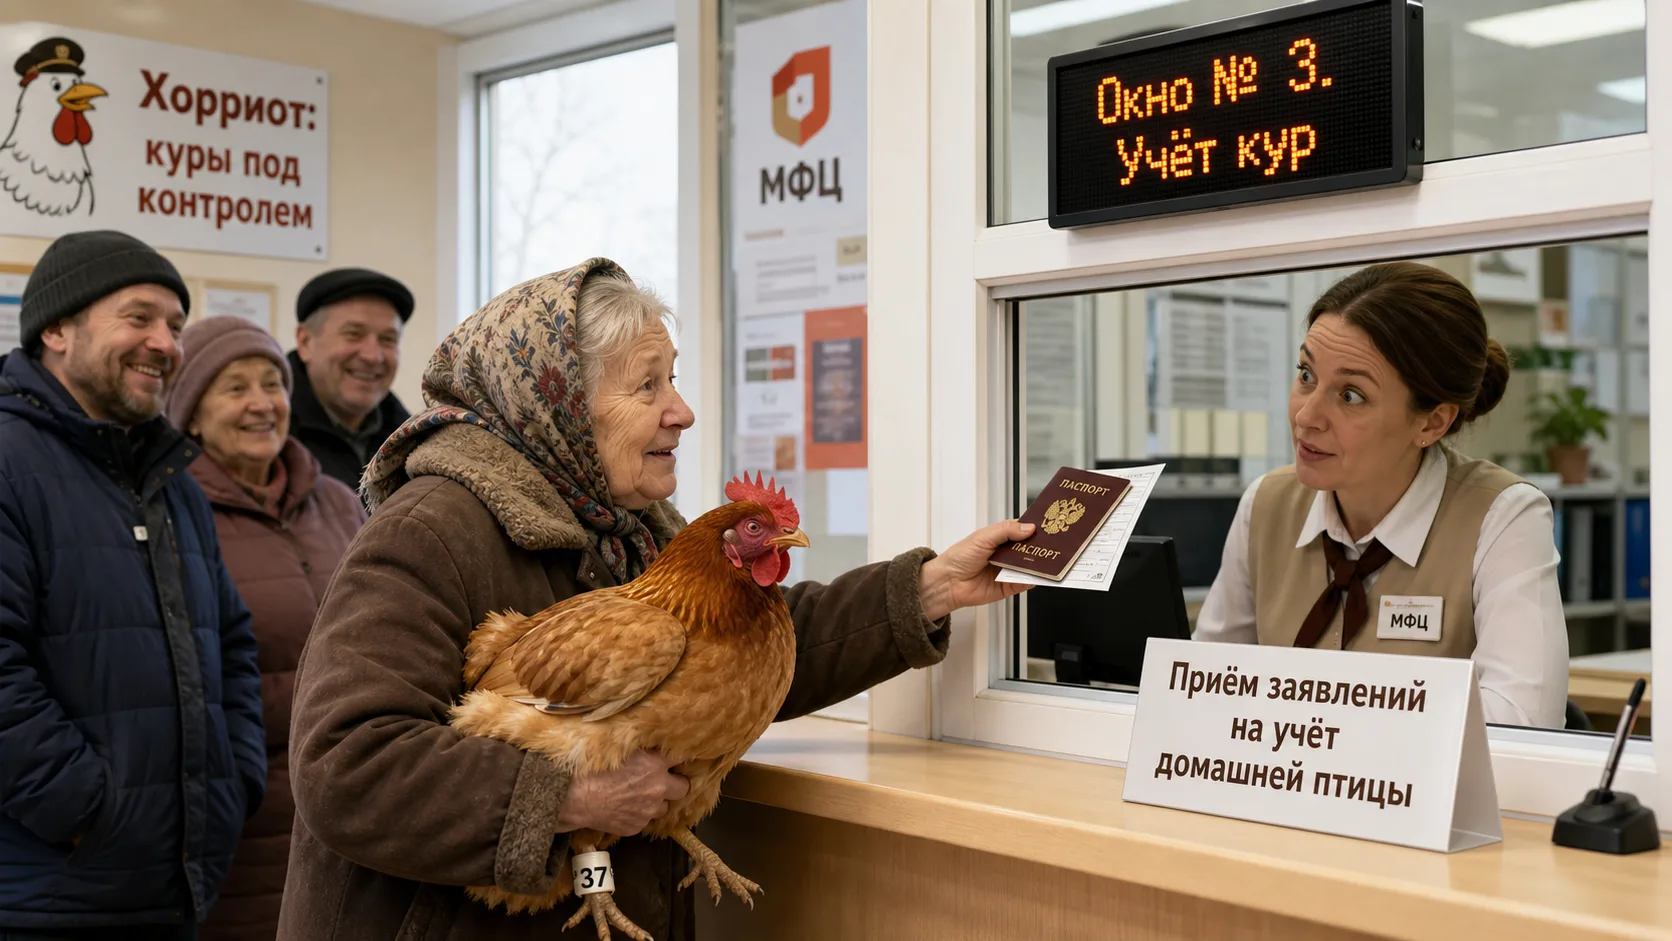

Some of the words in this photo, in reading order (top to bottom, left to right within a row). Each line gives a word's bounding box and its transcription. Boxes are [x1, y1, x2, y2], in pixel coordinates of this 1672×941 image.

[140, 69, 316, 131] Хорриот:
[1097, 76, 1193, 125] Окно
[1213, 55, 1257, 106] №
[1288, 37, 1332, 92] 3.
[146, 139, 231, 179] куры
[243, 151, 301, 187] под
[1116, 128, 1217, 186] Учёт
[1238, 124, 1316, 176] кур
[760, 157, 843, 205] МФЦ
[138, 186, 313, 229] контролем
[1059, 479, 1111, 496] ПАСПОРТ
[1011, 542, 1061, 560] ПАСПОРТ
[1390, 613, 1428, 632] МФЦ
[1169, 660, 1259, 699] Приём
[1266, 677, 1427, 713] заявлений
[1230, 717, 1263, 743] на
[1271, 717, 1340, 752] учёт
[1154, 752, 1304, 793] домашней
[1313, 771, 1413, 810] птицы
[580, 866, 608, 889] 37
